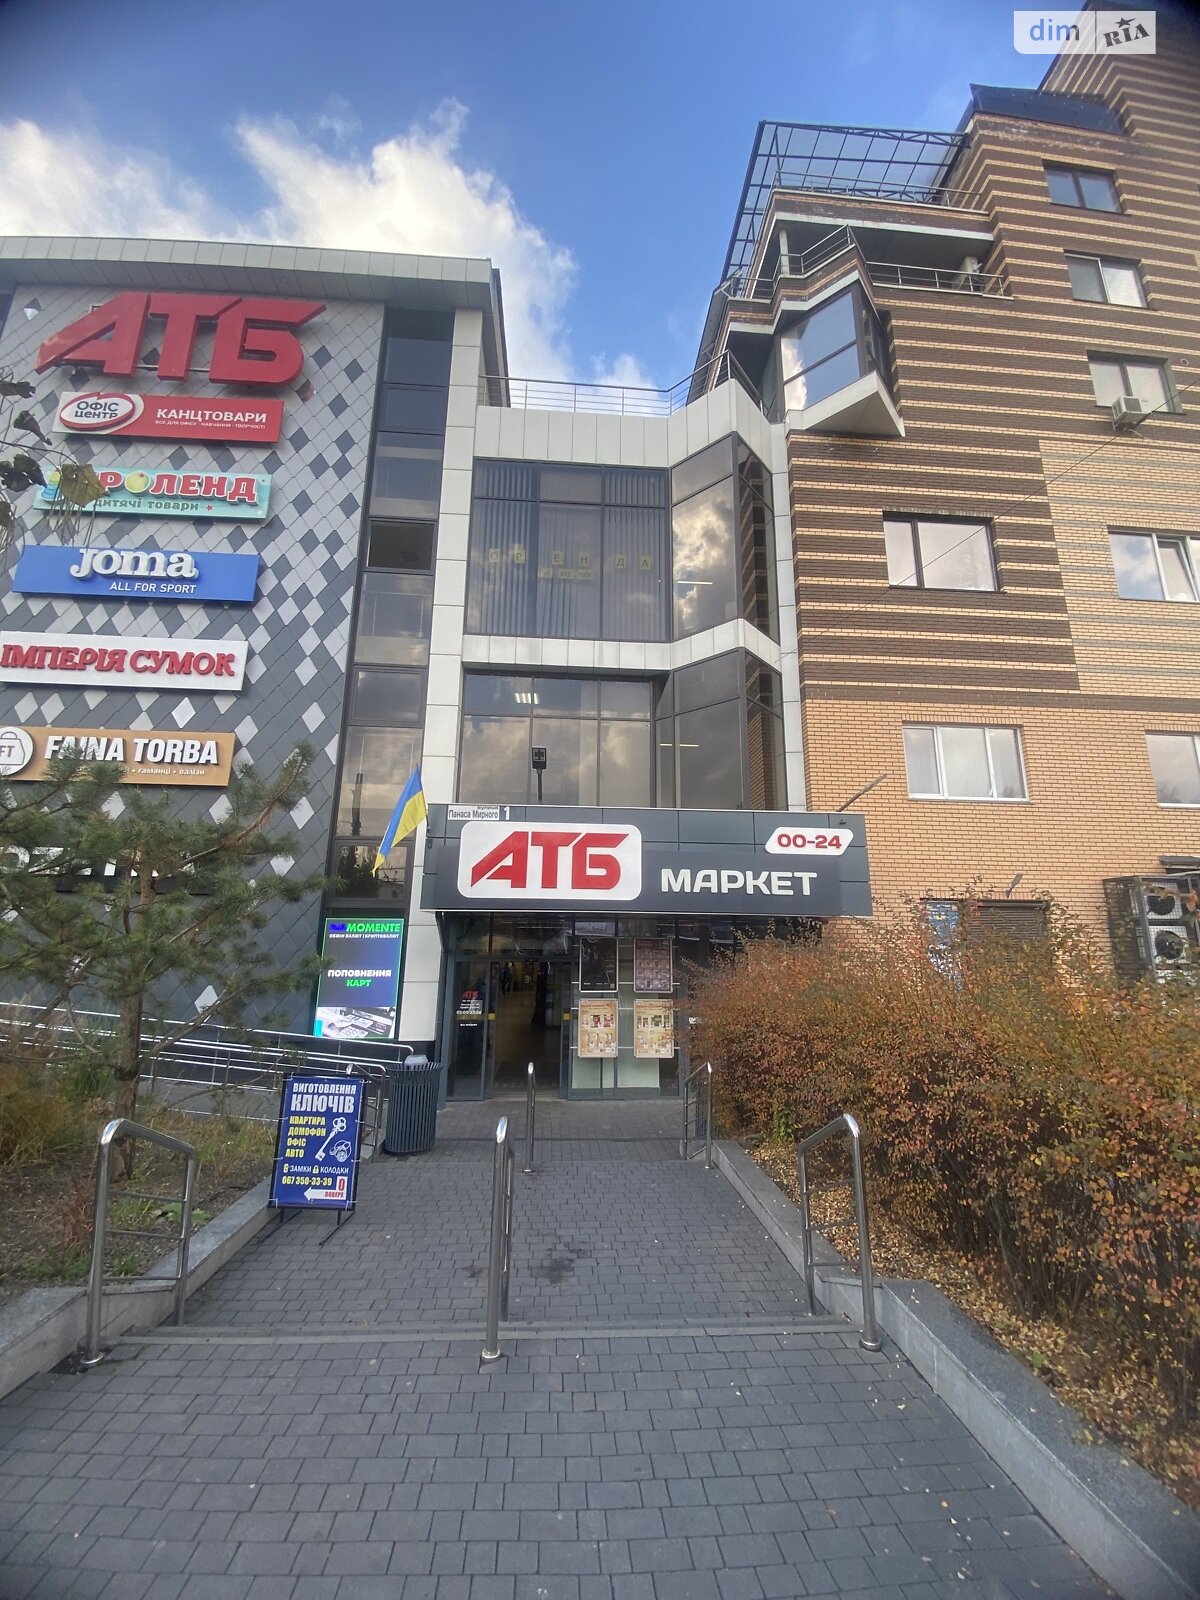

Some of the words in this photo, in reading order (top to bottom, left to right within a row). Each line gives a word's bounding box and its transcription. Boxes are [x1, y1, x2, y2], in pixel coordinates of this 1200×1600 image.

[34, 291, 327, 386] АТБ
[76, 400, 119, 412] ОФІС
[156, 408, 267, 423] КАНЦТОВАРИ
[147, 500, 199, 512] товари
[109, 581, 131, 592] ALL
[134, 582, 157, 593] FOR
[160, 583, 197, 594] SPORT
[0, 644, 128, 673] ІМПЕРІЯ
[129, 650, 236, 677] СУМОК
[133, 738, 219, 765] TORBA
[448, 809, 471, 819] Панаса
[472, 810, 499, 820] Мирного
[503, 805, 510, 821] 1
[777, 832, 842, 849] 00-24
[470, 830, 630, 890] АТБ
[660, 868, 818, 897] МАРКЕТ
[346, 922, 401, 932] MOMENTE
[327, 969, 392, 978] ПОПОВНЕННЯ
[346, 979, 372, 987] КАРТ
[292, 1082, 357, 1095] ВИГОТОВЛЕННЯ
[290, 1094, 355, 1113] КЛЮЧІВ
[289, 1115, 326, 1126] КВАРТИРА
[287, 1126, 326, 1137] ДОМОФОН
[286, 1137, 307, 1147] ОФІС
[285, 1148, 305, 1158] АВТО
[289, 1165, 312, 1173] ЗАМКИ
[320, 1166, 349, 1175] КОЛОДКИ
